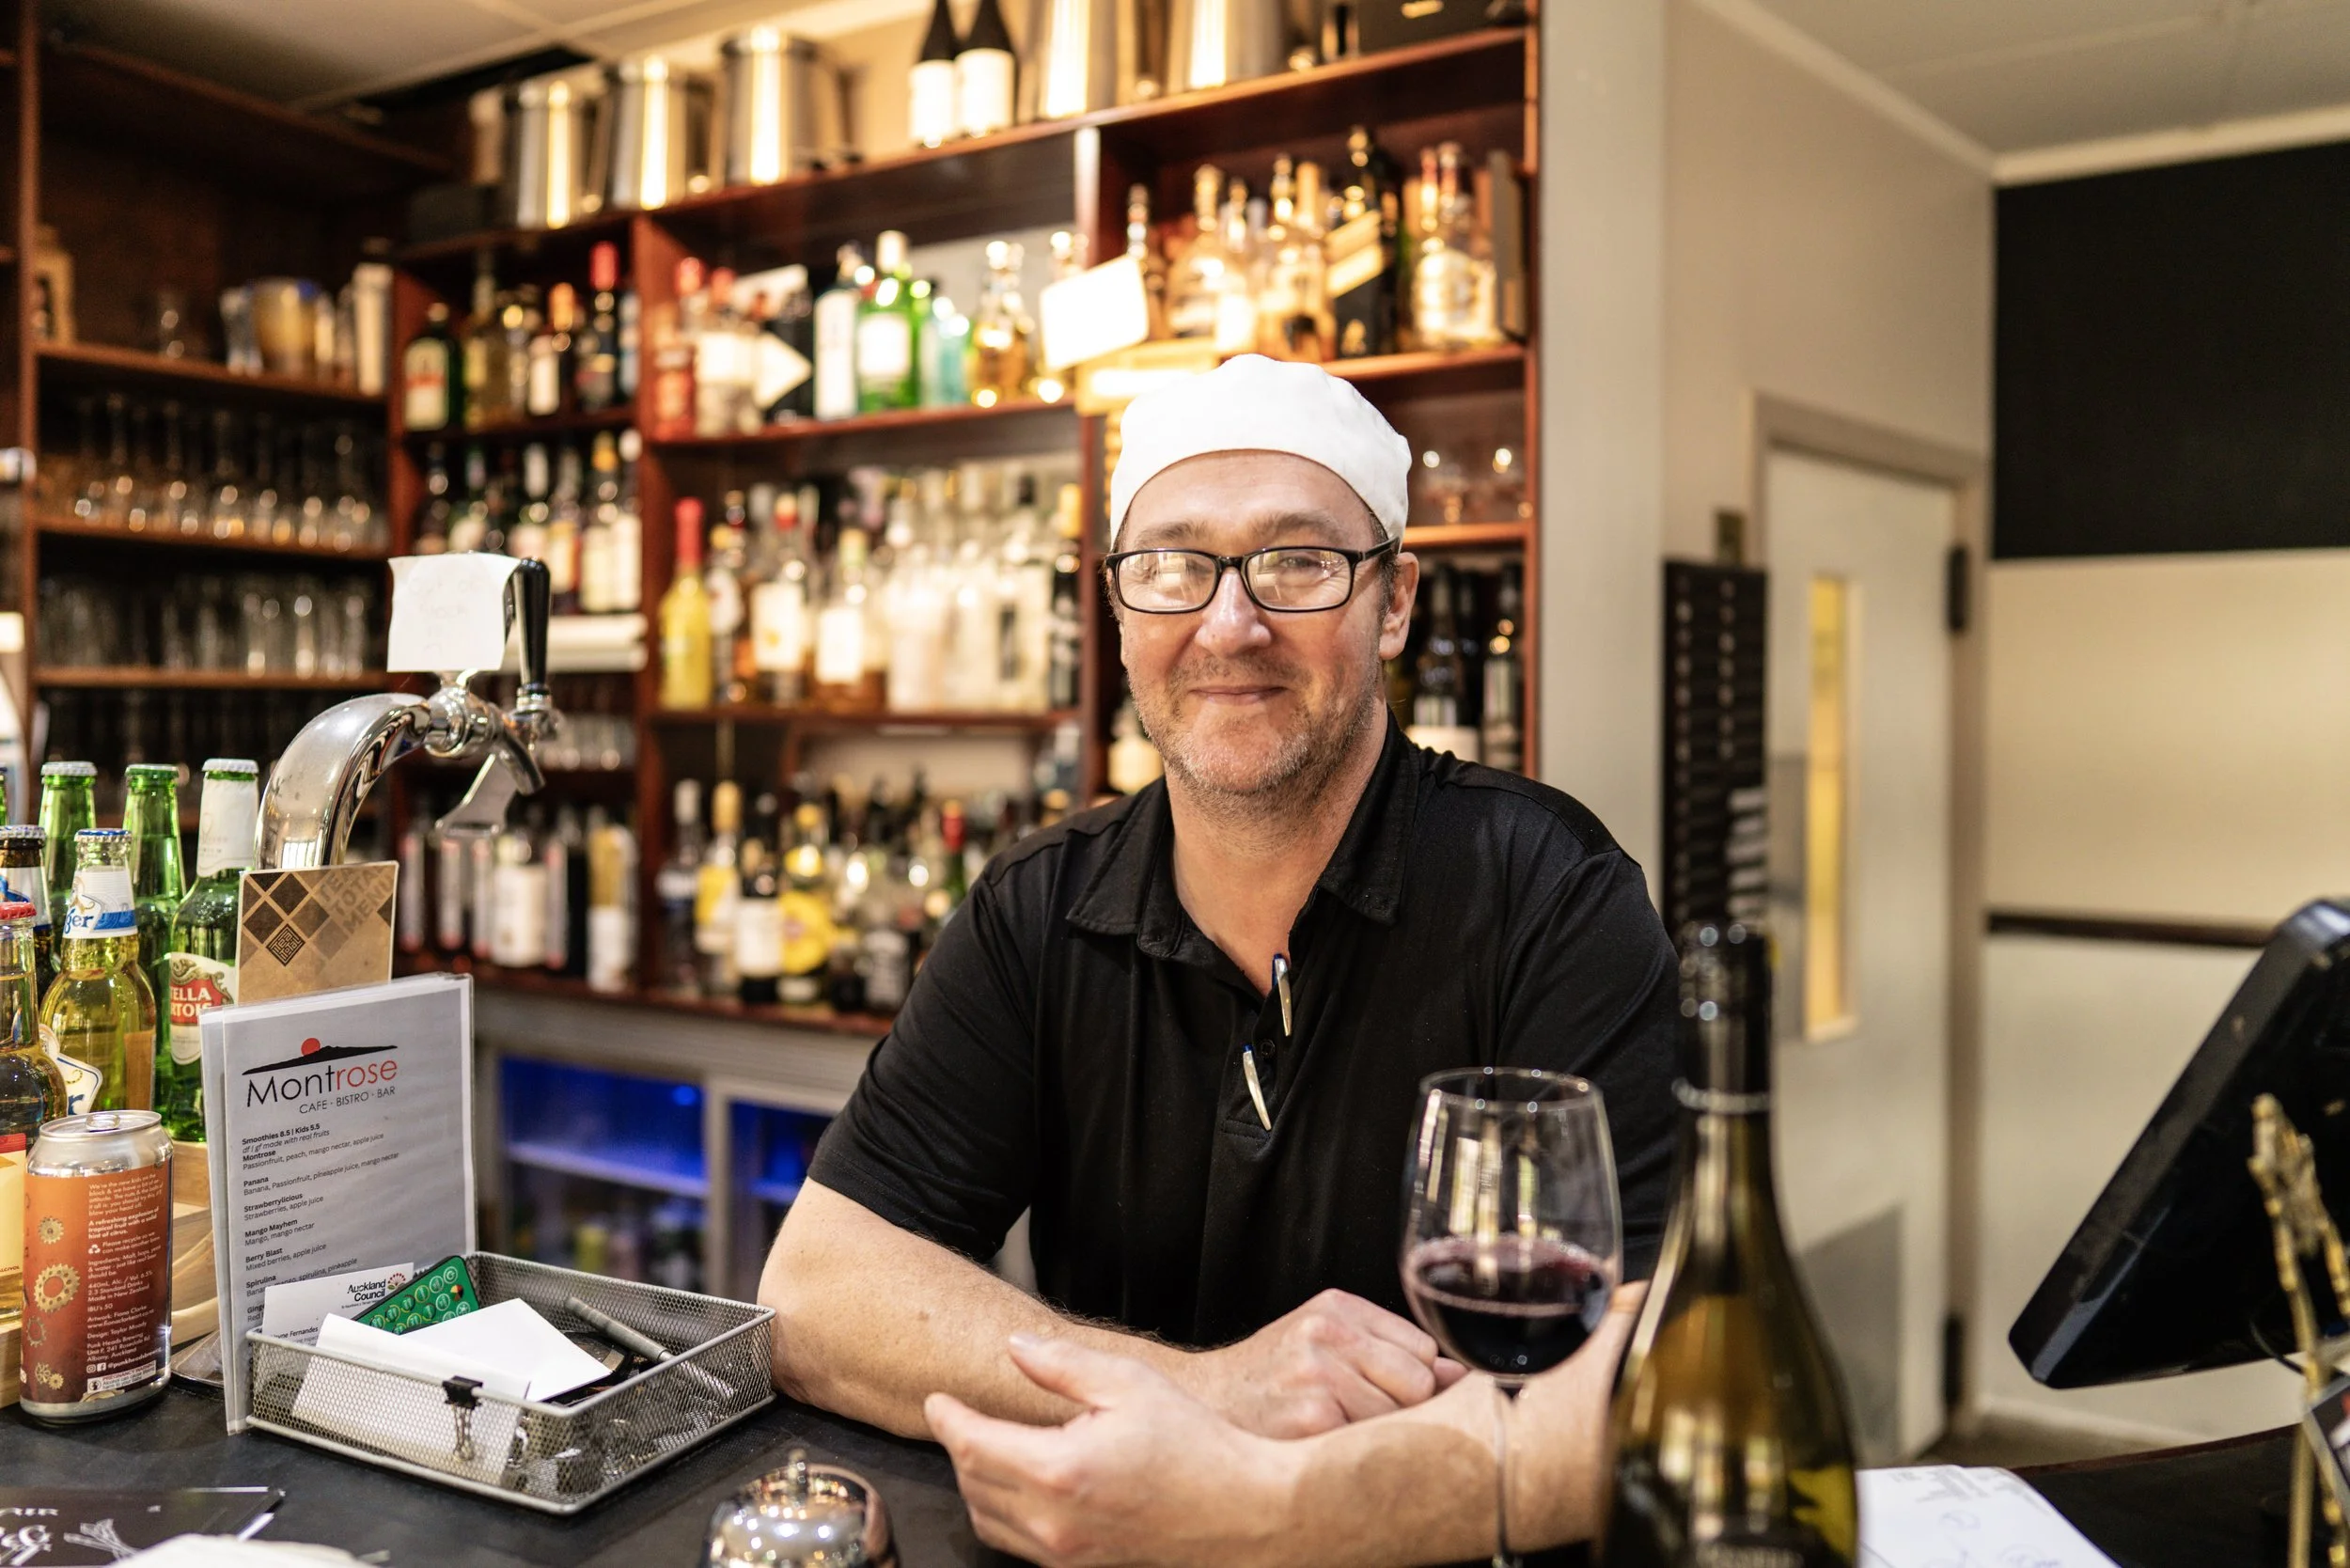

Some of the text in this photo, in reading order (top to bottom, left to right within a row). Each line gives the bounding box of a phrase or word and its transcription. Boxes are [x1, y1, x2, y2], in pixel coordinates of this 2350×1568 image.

[342, 872, 394, 934] MENU
[247, 1060, 398, 1107] Montrose
[299, 1086, 395, 1114] CAFE BISTRO BAR
[242, 1123, 321, 1146] Smoothies 8.5 Kids 5.5
[263, 1140, 282, 1150] made
[284, 1137, 298, 1145] with
[299, 1134, 312, 1142] real
[313, 1130, 330, 1139] fruits
[243, 1133, 384, 1170] Passionfruit, peach, mango nectar, apple juice
[243, 1150, 276, 1162] Montrose
[243, 1152, 400, 1196] Banana, Passionfruit, pineapple juice, mango nectar
[243, 1177, 269, 1187] Panana
[244, 1193, 303, 1213] Strawberrylicious
[244, 1196, 323, 1221] Strawberries, apple juice
[88, 1225, 113, 1233] tropical
[95, 1216, 127, 1226] refreshing
[244, 1219, 298, 1238] Mango Mayhem
[244, 1222, 315, 1247] Mango, mango nectar
[245, 1247, 283, 1263] Berry Blast
[245, 1244, 326, 1271] Mixed berries, apple juice
[328, 1258, 357, 1273] pineapple
[246, 1275, 276, 1289] Spirulina
[347, 1279, 386, 1294] Auckland
[354, 1289, 385, 1302] Council
[290, 1326, 319, 1337] Fernandes
